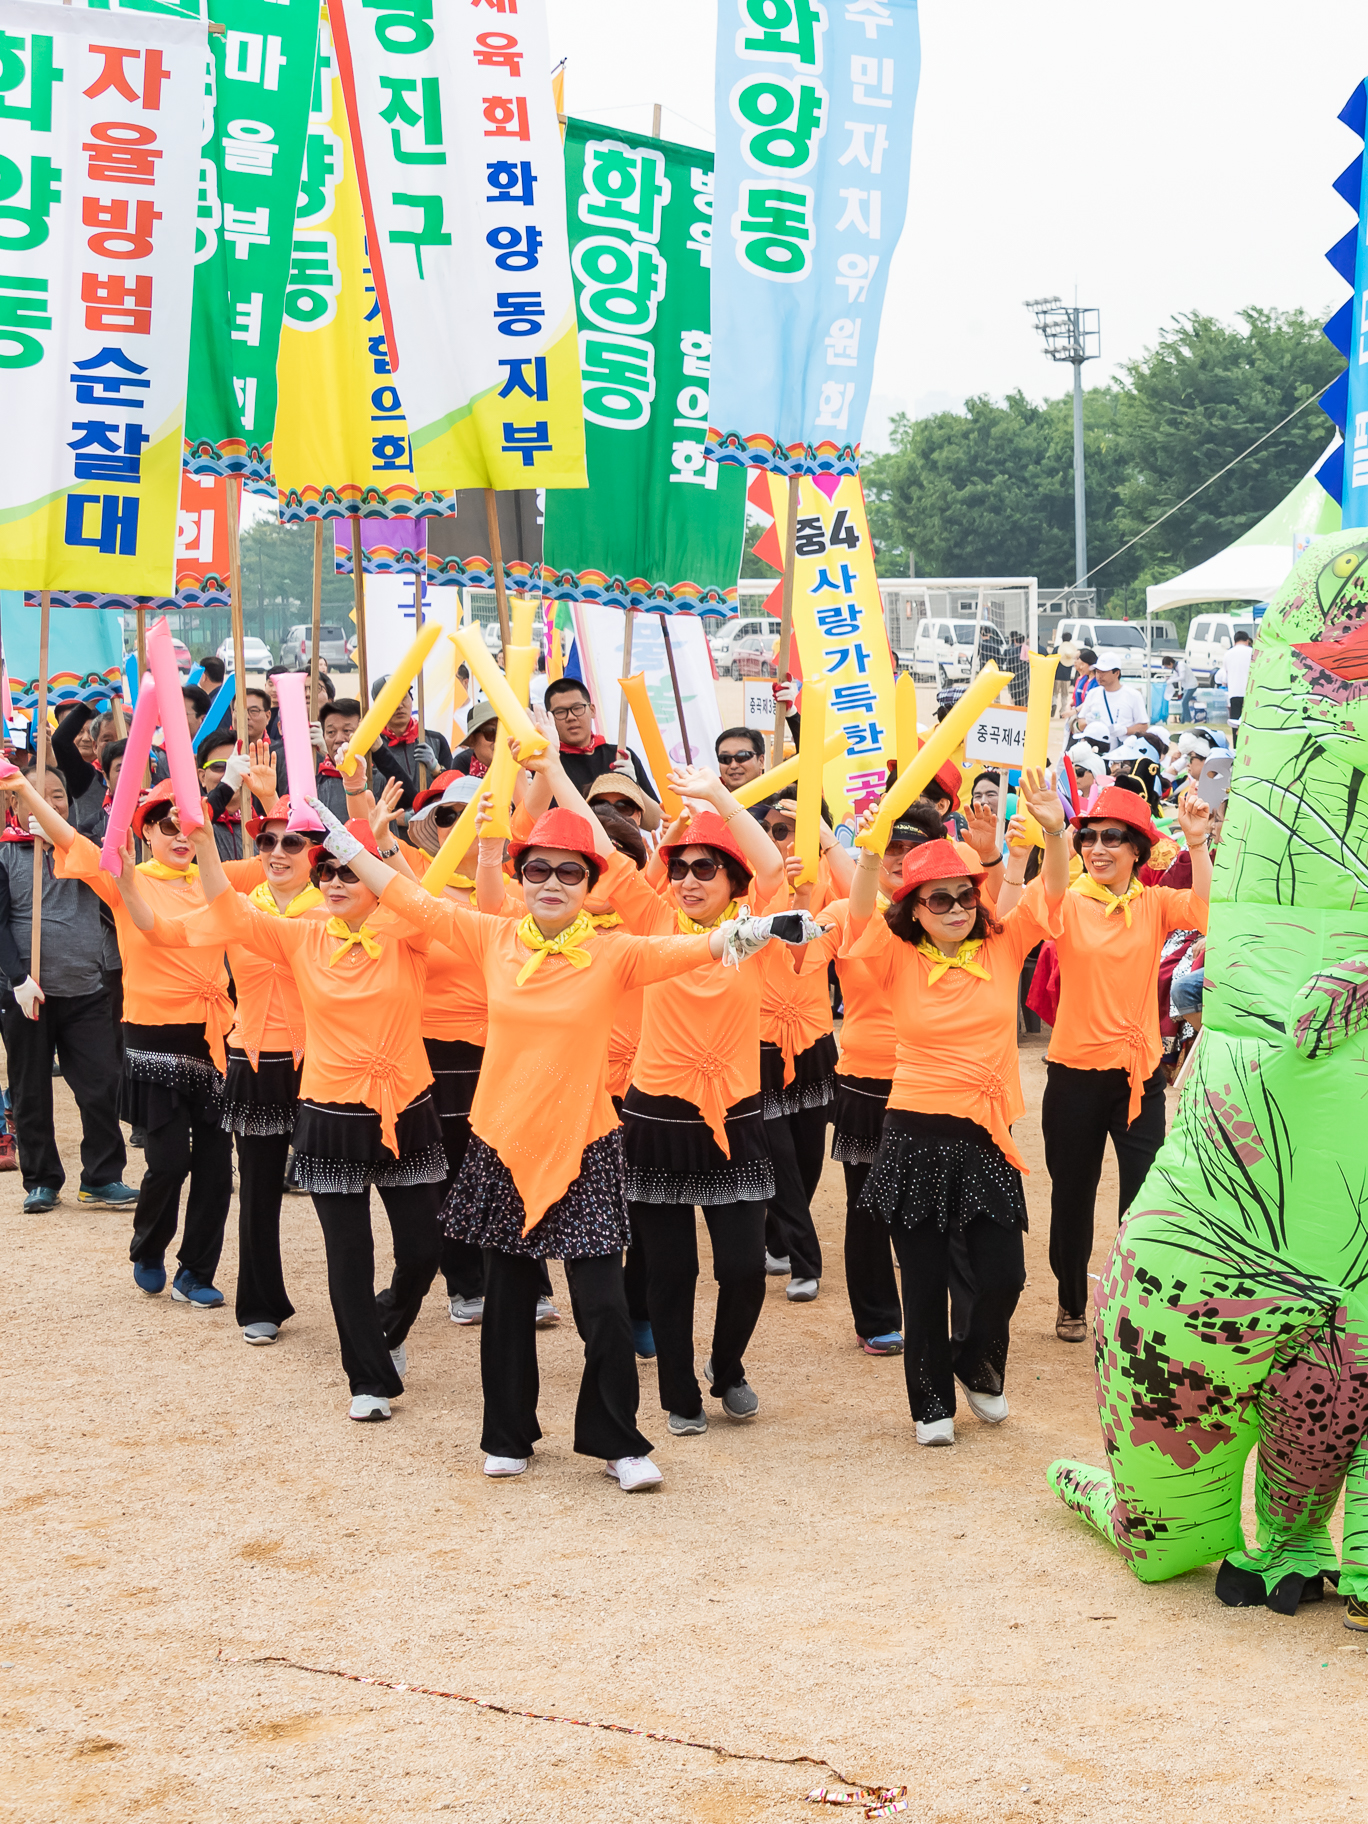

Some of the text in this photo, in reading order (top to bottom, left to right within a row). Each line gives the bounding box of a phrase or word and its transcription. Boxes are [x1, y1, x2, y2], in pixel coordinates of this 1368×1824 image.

[735, 0, 825, 276] 화양동
[577, 145, 667, 424] 화양동
[795, 509, 860, 556] 중4
